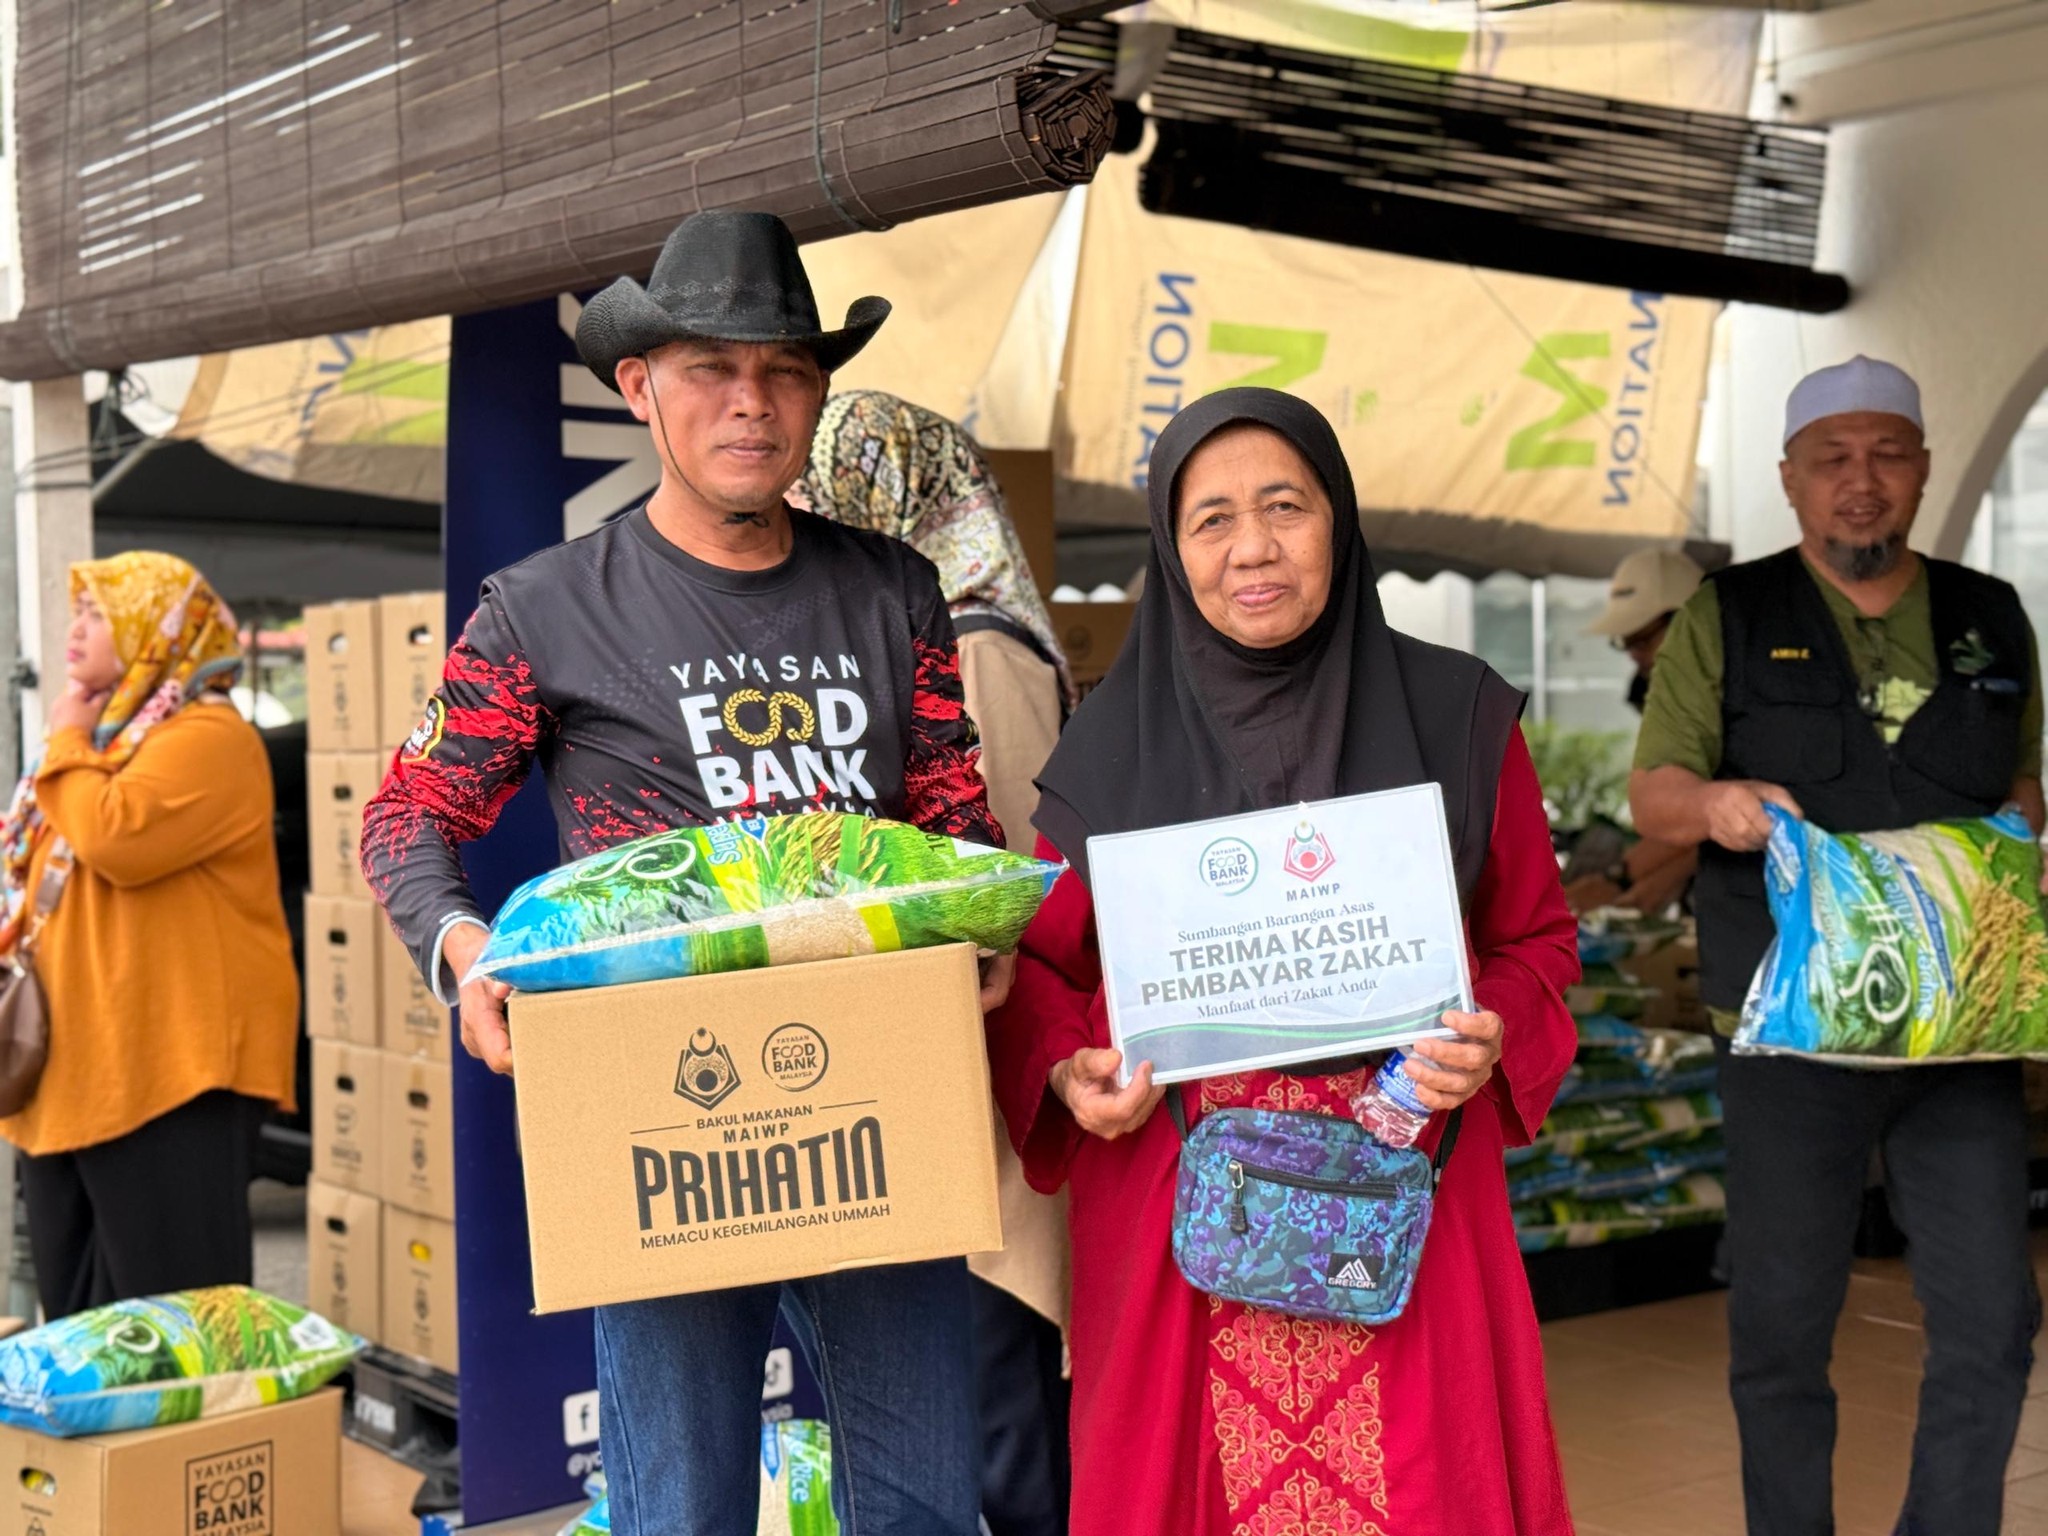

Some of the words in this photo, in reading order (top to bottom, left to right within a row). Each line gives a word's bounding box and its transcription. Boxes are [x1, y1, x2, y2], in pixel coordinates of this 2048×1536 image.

[669, 653, 861, 689] YAYASAN
[679, 688, 868, 756] FOOD
[696, 745, 877, 809] BANK
[1208, 853, 1247, 870] FOOD
[1209, 865, 1249, 881] BANK
[1215, 878, 1246, 888] MALAYSIA
[1286, 883, 1341, 902] MAIWP
[1178, 919, 1262, 944] Sumbangan
[1265, 906, 1336, 931] Barangan
[1339, 900, 1376, 917] Asas
[1170, 932, 1288, 973] TERIMA
[1292, 916, 1390, 953] KASIH
[1141, 956, 1314, 1006] PEMBAYAR
[1321, 938, 1427, 976] ZAKAT
[1197, 998, 1258, 1020] Manfaat
[1259, 991, 1290, 1010] dari
[1291, 983, 1334, 1003] Zakat
[1337, 977, 1379, 995] Anda
[772, 1042, 816, 1061] FOOD
[773, 1056, 818, 1073] BANK
[780, 1070, 813, 1080] MALAYSIA
[696, 1114, 741, 1130] BAKUL
[742, 1104, 813, 1125] MAKANAN
[723, 1122, 790, 1144] MAIWP
[631, 1115, 888, 1231] PRIHATIN
[641, 1229, 709, 1250] MEMACU
[713, 1212, 829, 1240] KEGEMILANGAN
[832, 1203, 891, 1224] UMMAH
[1328, 1276, 1377, 1289] GREGORY
[195, 1451, 266, 1480] YAYASAN
[195, 1470, 265, 1509] FOOD
[195, 1493, 266, 1531] BANK
